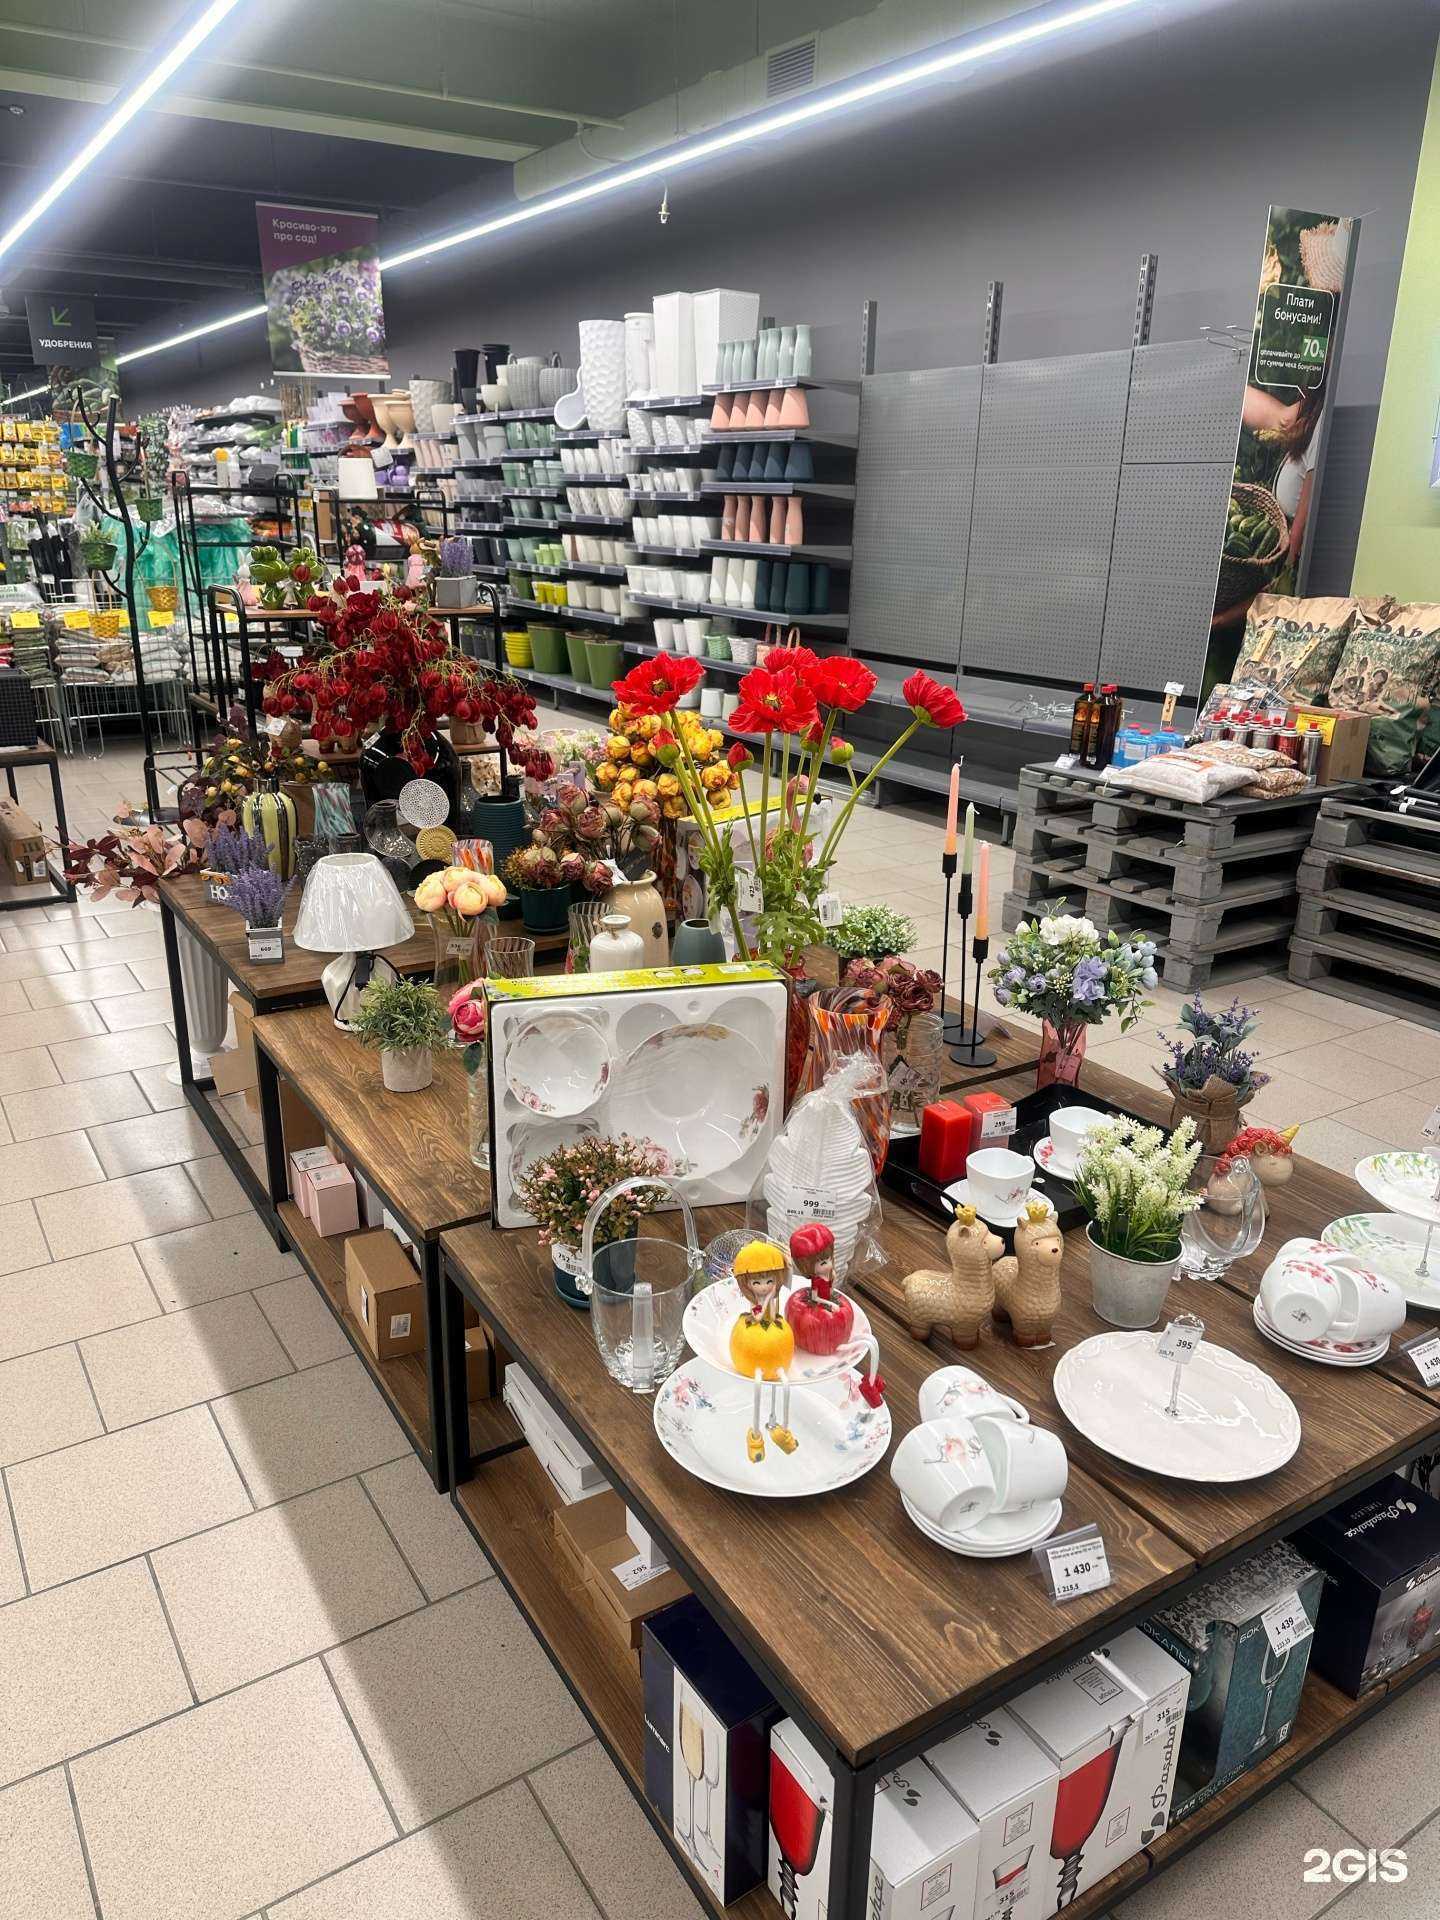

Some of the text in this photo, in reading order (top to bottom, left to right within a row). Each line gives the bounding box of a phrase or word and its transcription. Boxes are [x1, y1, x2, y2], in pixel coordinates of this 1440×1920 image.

[273, 232, 317, 244] про сад!
[1286, 293, 1315, 309] Плати
[1274, 307, 1322, 325] бонусами!
[38, 338, 93, 350] УДОБРЕНИЯ
[1260, 359, 1322, 372] от суммы чека бонусами
[803, 1199, 819, 1208] 999
[1176, 1339, 1193, 1350] 395
[1064, 1562, 1091, 1578] 1 430
[1276, 1616, 1295, 1636] 1 439
[1142, 1621, 1191, 1667] ОКАЛЫ
[1156, 1707, 1171, 1722] 315
